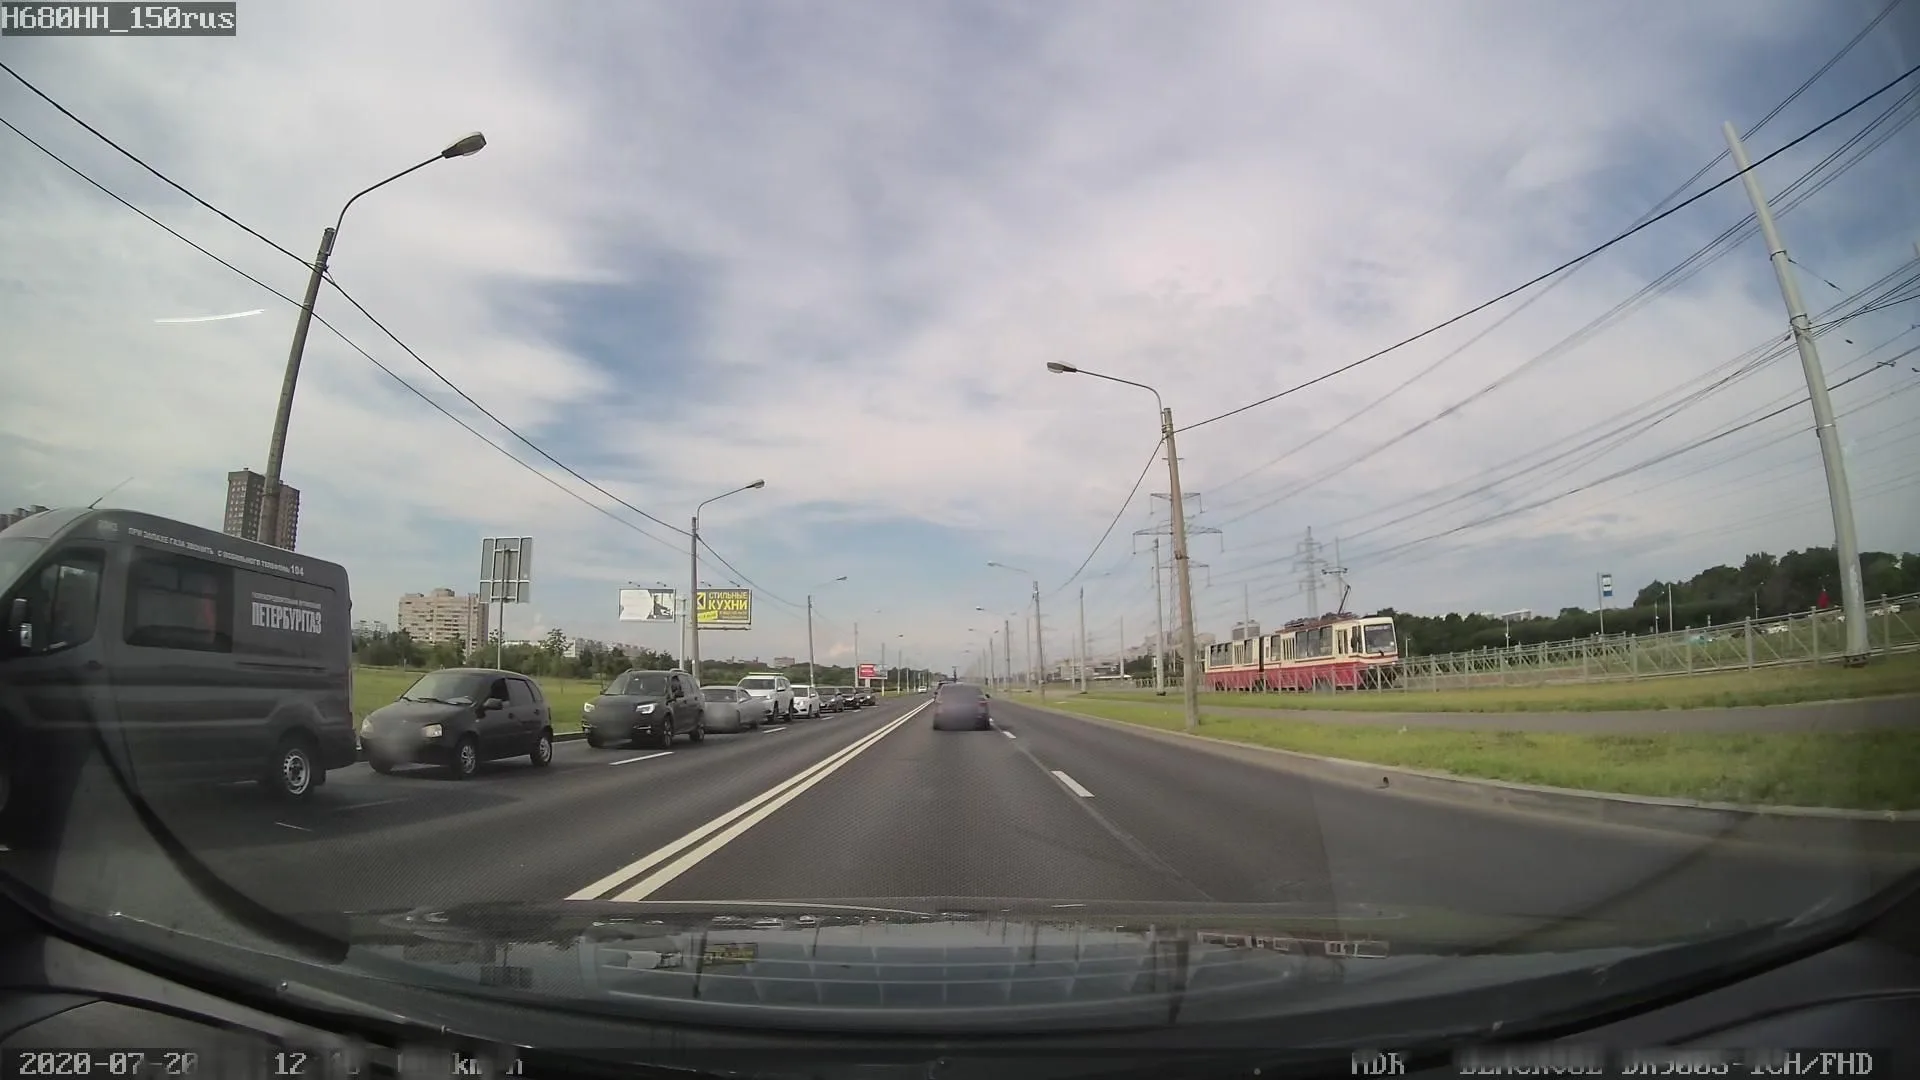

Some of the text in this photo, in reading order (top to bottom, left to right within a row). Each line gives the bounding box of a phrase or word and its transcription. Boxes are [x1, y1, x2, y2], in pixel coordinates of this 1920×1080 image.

[291, 564, 304, 576] 104
[708, 592, 748, 600] СТИЛЬНЫЕ
[708, 600, 748, 610] КУХНИ
